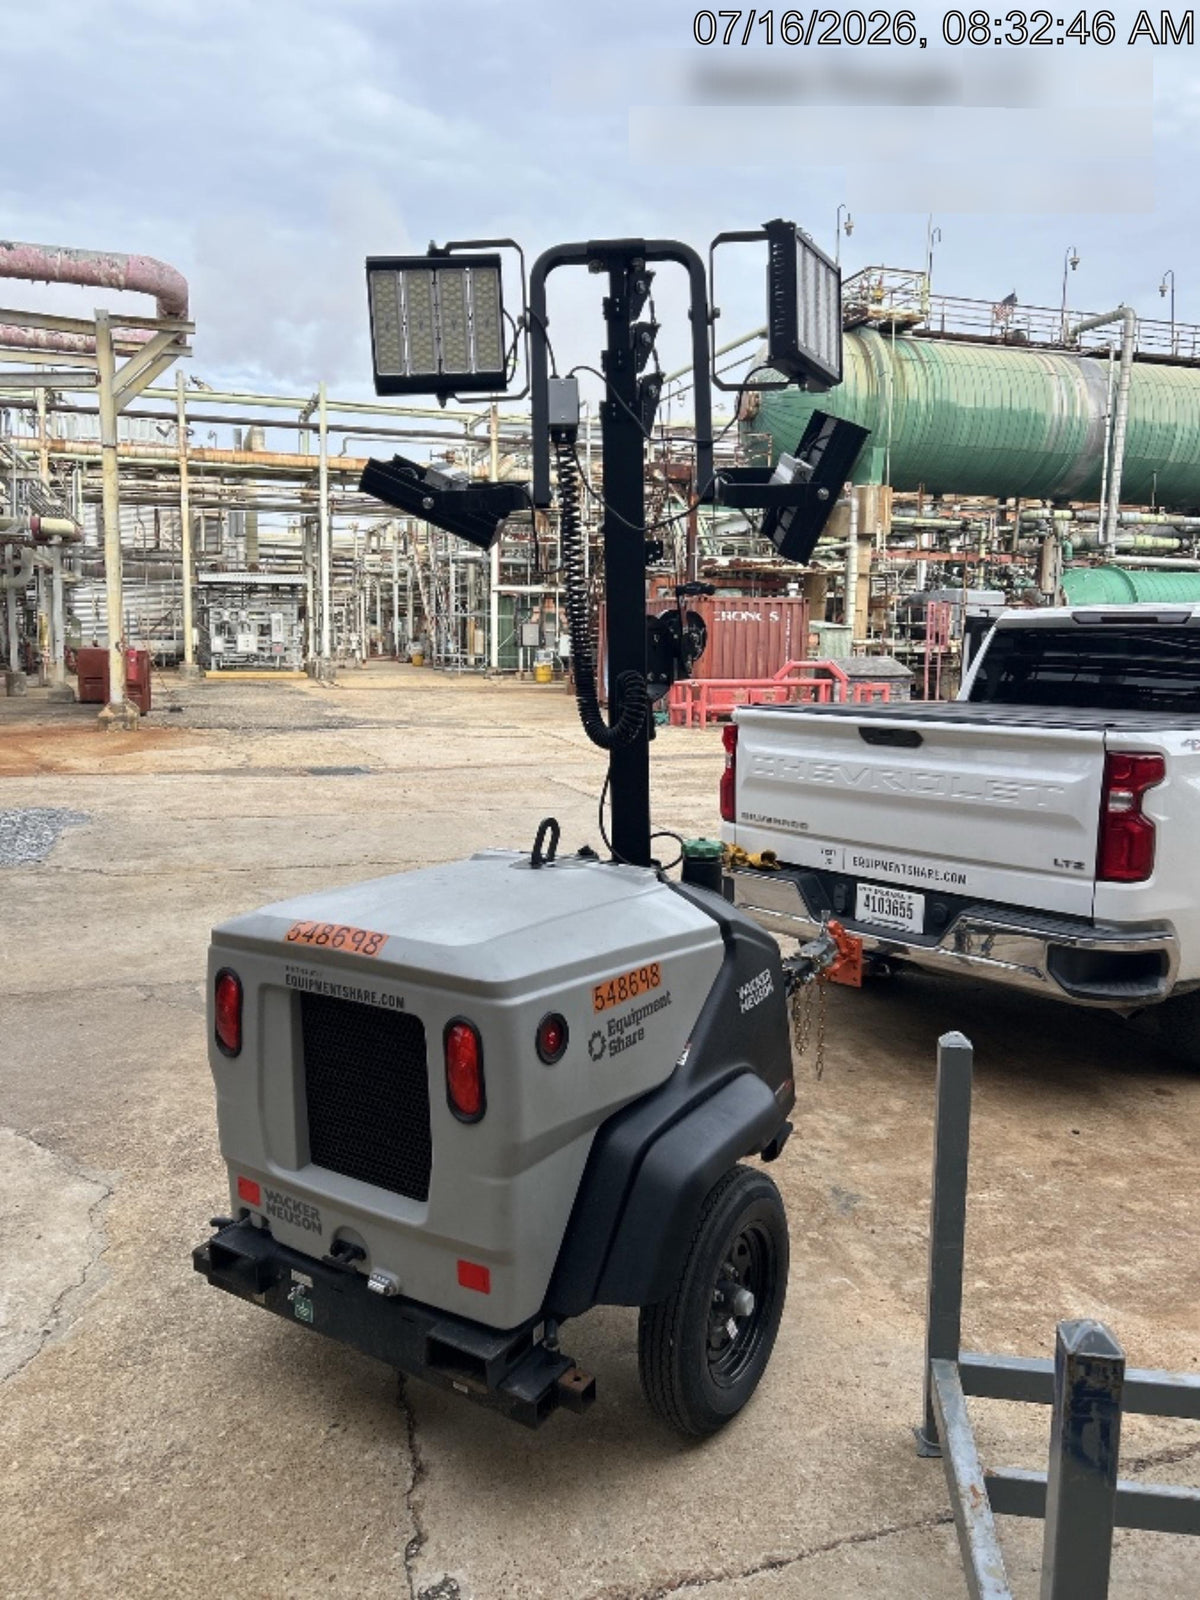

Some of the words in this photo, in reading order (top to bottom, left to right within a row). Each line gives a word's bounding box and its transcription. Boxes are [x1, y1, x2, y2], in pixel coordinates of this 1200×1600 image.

[751, 755, 1066, 807] CHEVROLET
[852, 856, 967, 885] EQUIPMENTSHARE.COM
[1053, 858, 1086, 871] LTZ
[864, 893, 914, 920] 4103655
[286, 921, 384, 956] 548698
[285, 973, 405, 1009] EQUIPMENTSHARE.COM
[594, 963, 662, 1012] 548698
[606, 990, 672, 1038] Equipment
[609, 1027, 646, 1057] Share
[264, 1187, 321, 1222] WACKER
[266, 1203, 323, 1236] NEUSON
